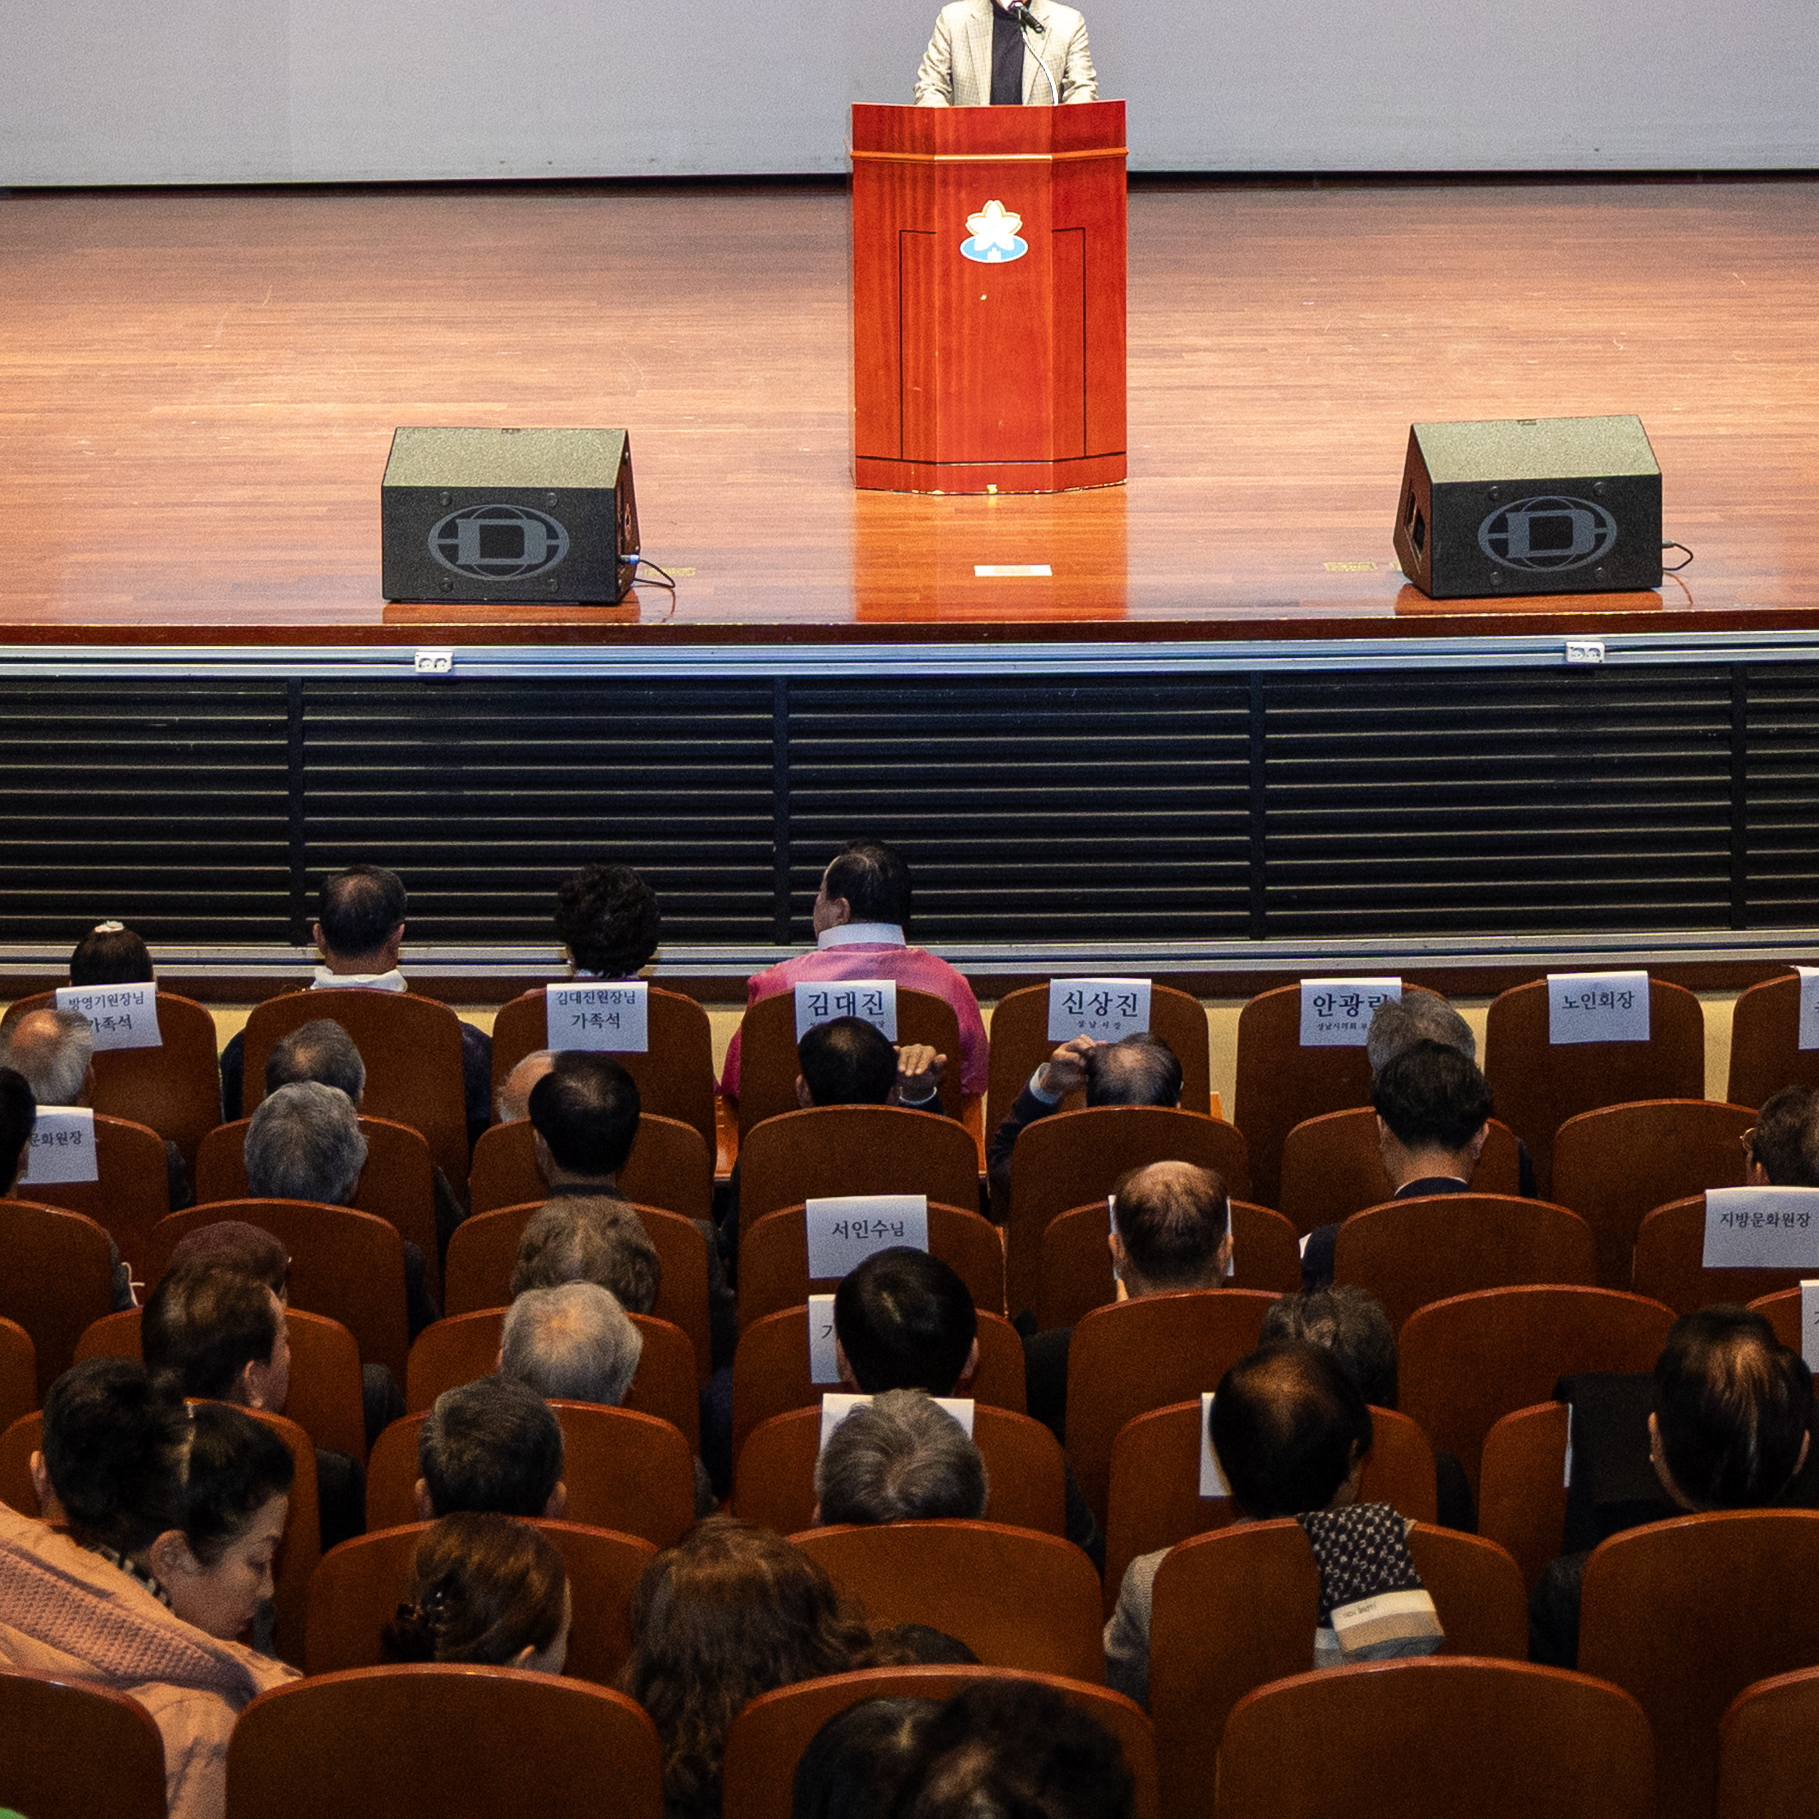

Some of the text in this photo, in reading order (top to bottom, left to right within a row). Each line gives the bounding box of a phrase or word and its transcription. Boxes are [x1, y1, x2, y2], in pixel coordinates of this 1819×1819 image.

[556, 990, 636, 1006] 김대진원장님
[808, 991, 885, 1017] 김대진
[1061, 990, 1138, 1017] 신상진
[1562, 991, 1635, 1011] 노인회장
[571, 1012, 621, 1030] 가족석
[831, 1220, 905, 1240] 서인수님
[1719, 1211, 1812, 1229] 지방문화원장
